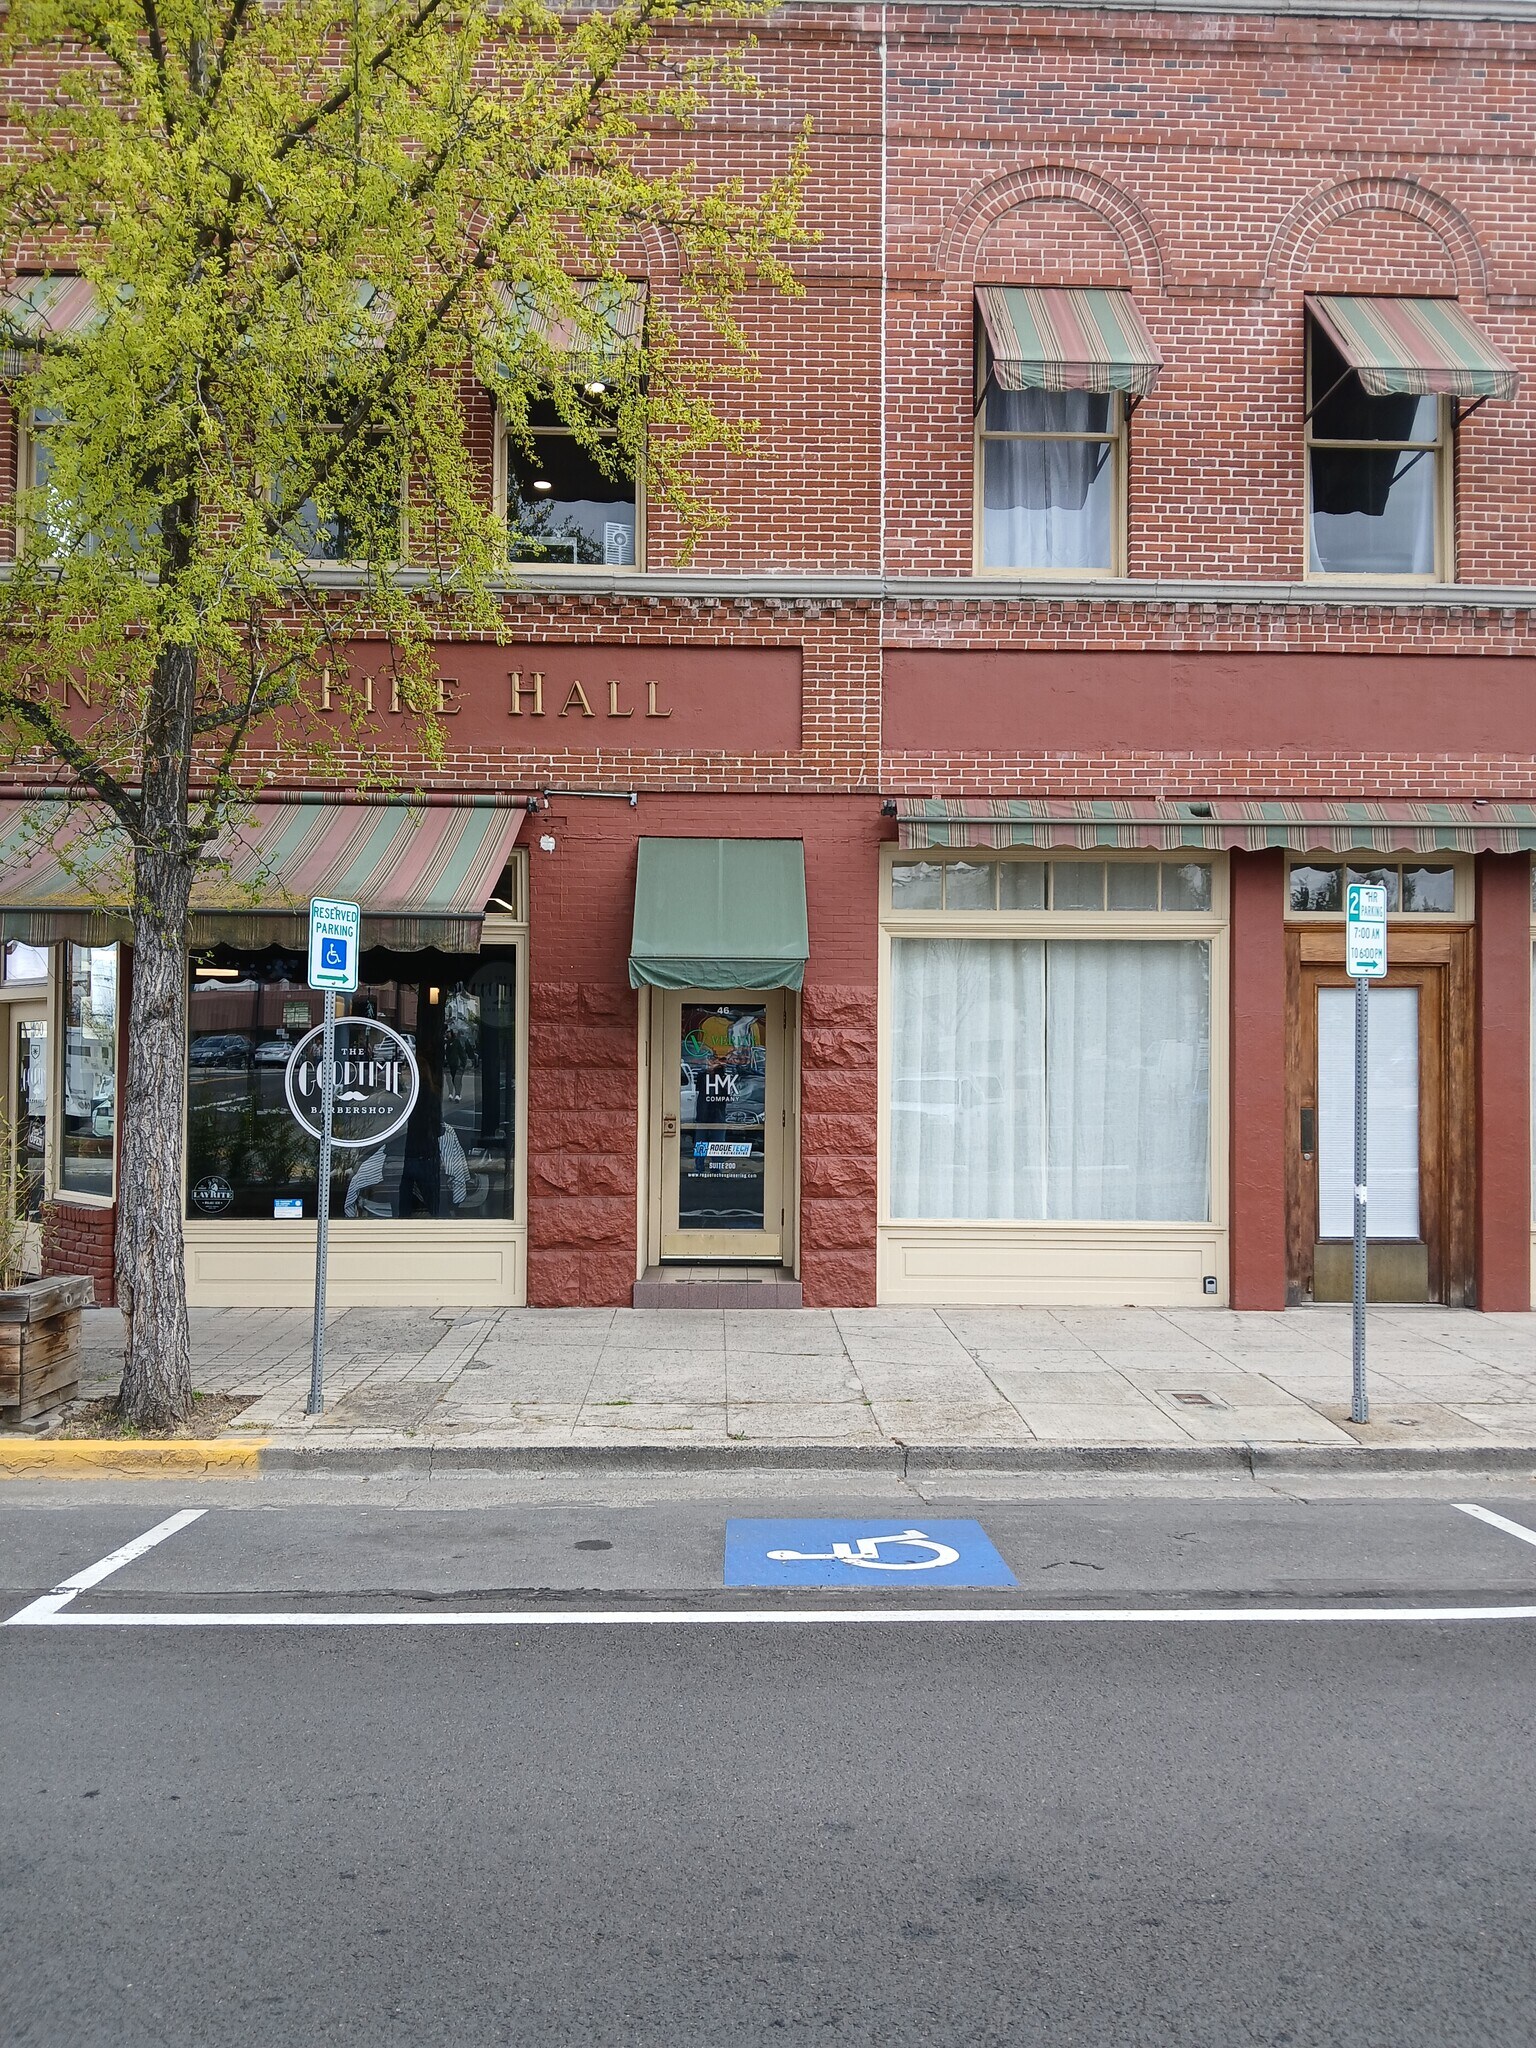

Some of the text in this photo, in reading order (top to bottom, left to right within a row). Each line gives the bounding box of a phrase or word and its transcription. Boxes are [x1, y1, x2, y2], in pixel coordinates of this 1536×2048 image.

[507, 670, 674, 717] HALL
[1350, 891, 1378, 914] 2 HR
[313, 906, 357, 924] RESERVED
[1361, 905, 1383, 917] PARKING
[316, 922, 354, 938] PARKING
[1354, 926, 1380, 940] 7:00 AM
[717, 1006, 730, 1015] 46
[341, 1048, 365, 1056] THE
[705, 1073, 740, 1096] HMK
[705, 1095, 740, 1103] COMPANY
